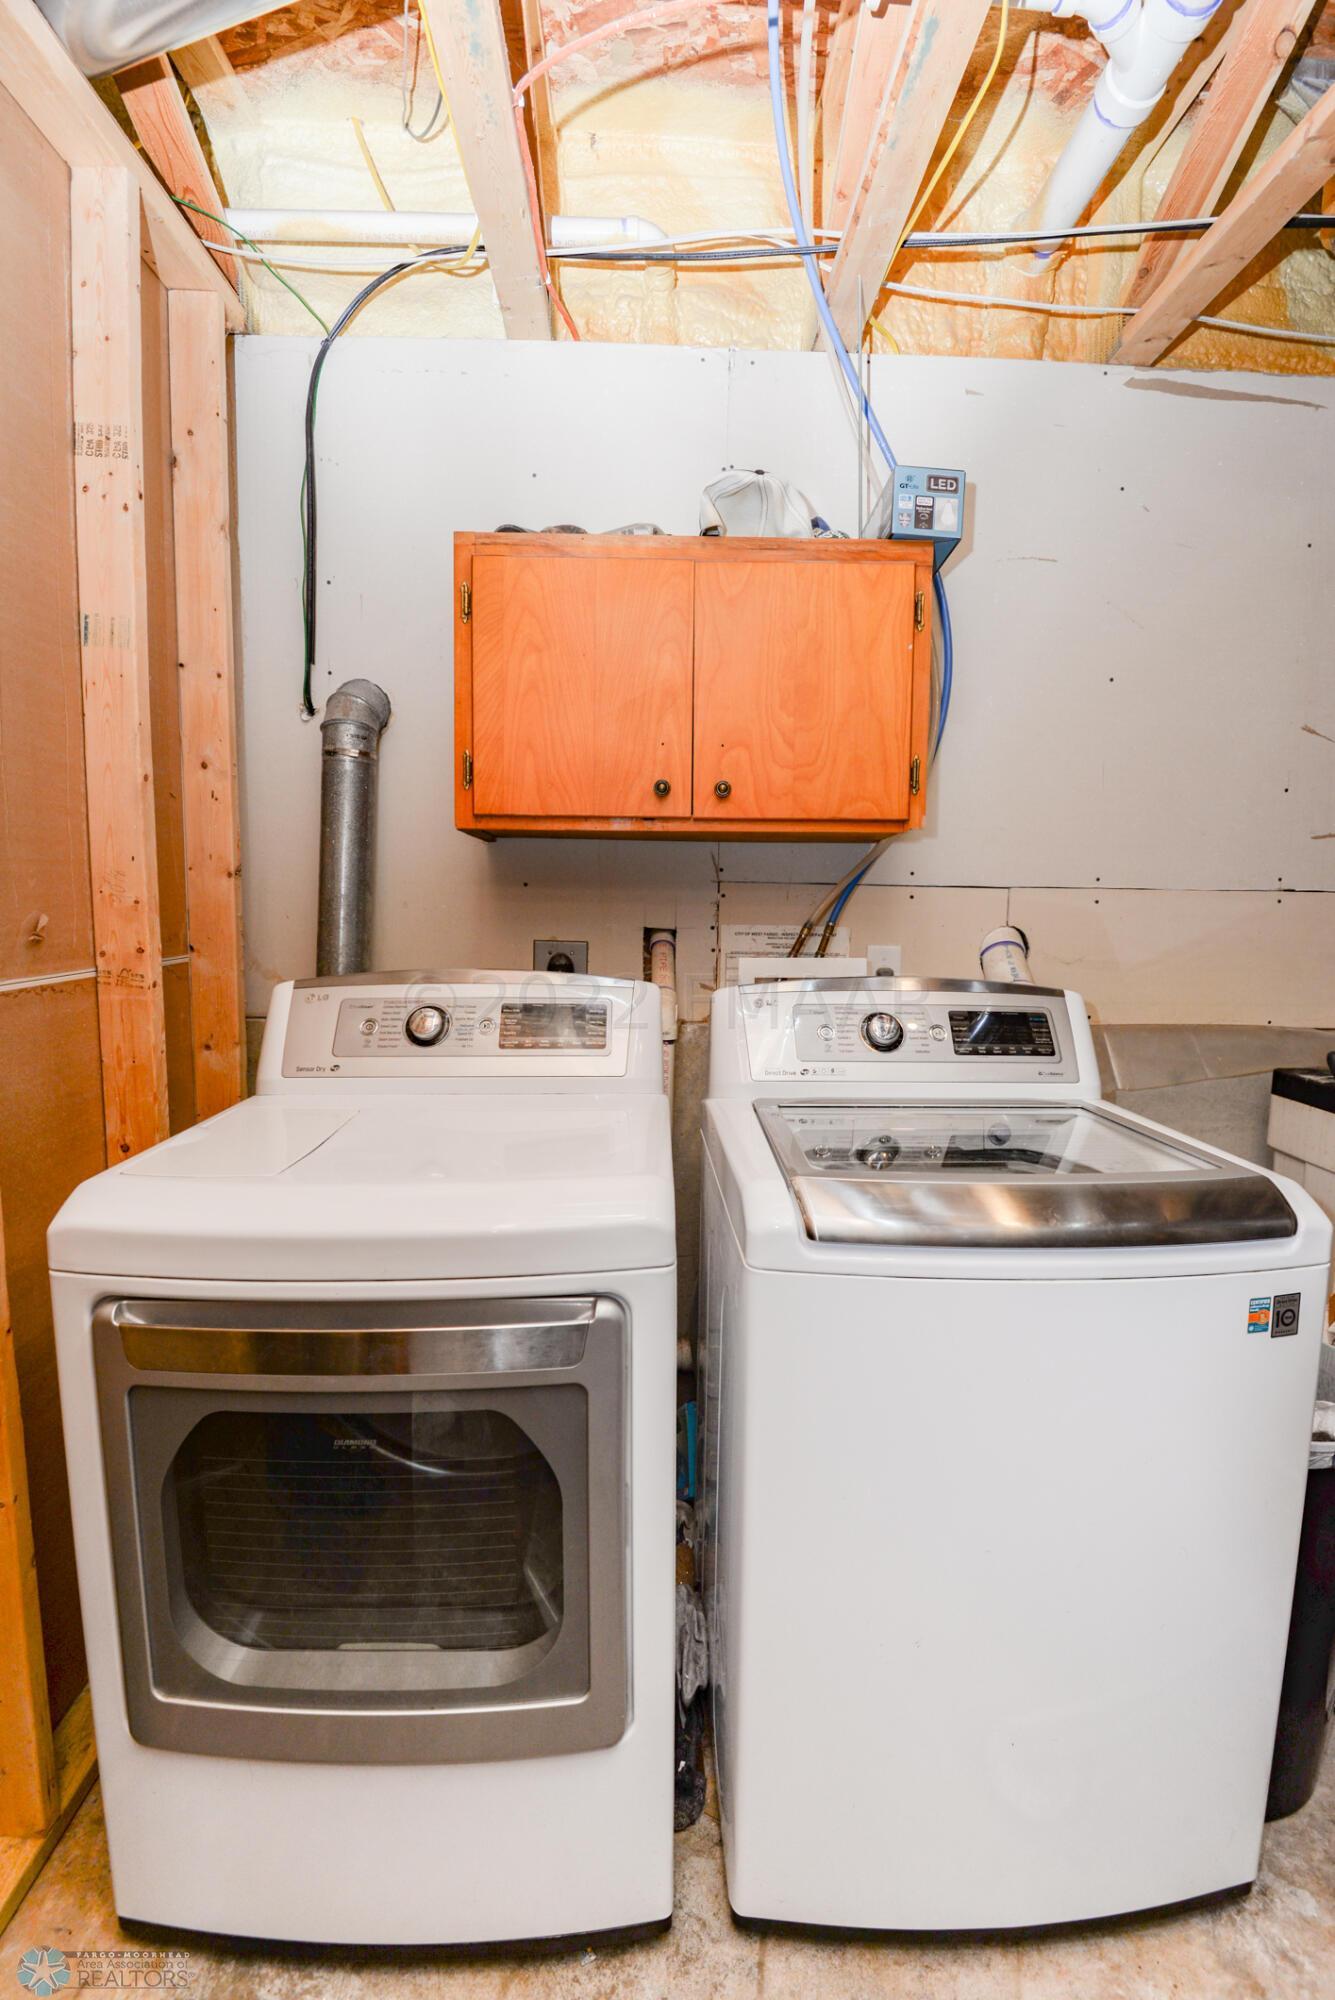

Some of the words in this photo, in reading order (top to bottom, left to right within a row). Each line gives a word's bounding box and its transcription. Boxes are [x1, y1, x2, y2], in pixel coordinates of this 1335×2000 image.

[930, 478, 957, 491] LED
[317, 993, 329, 1001] LG
[316, 1065, 327, 1074] Dry
